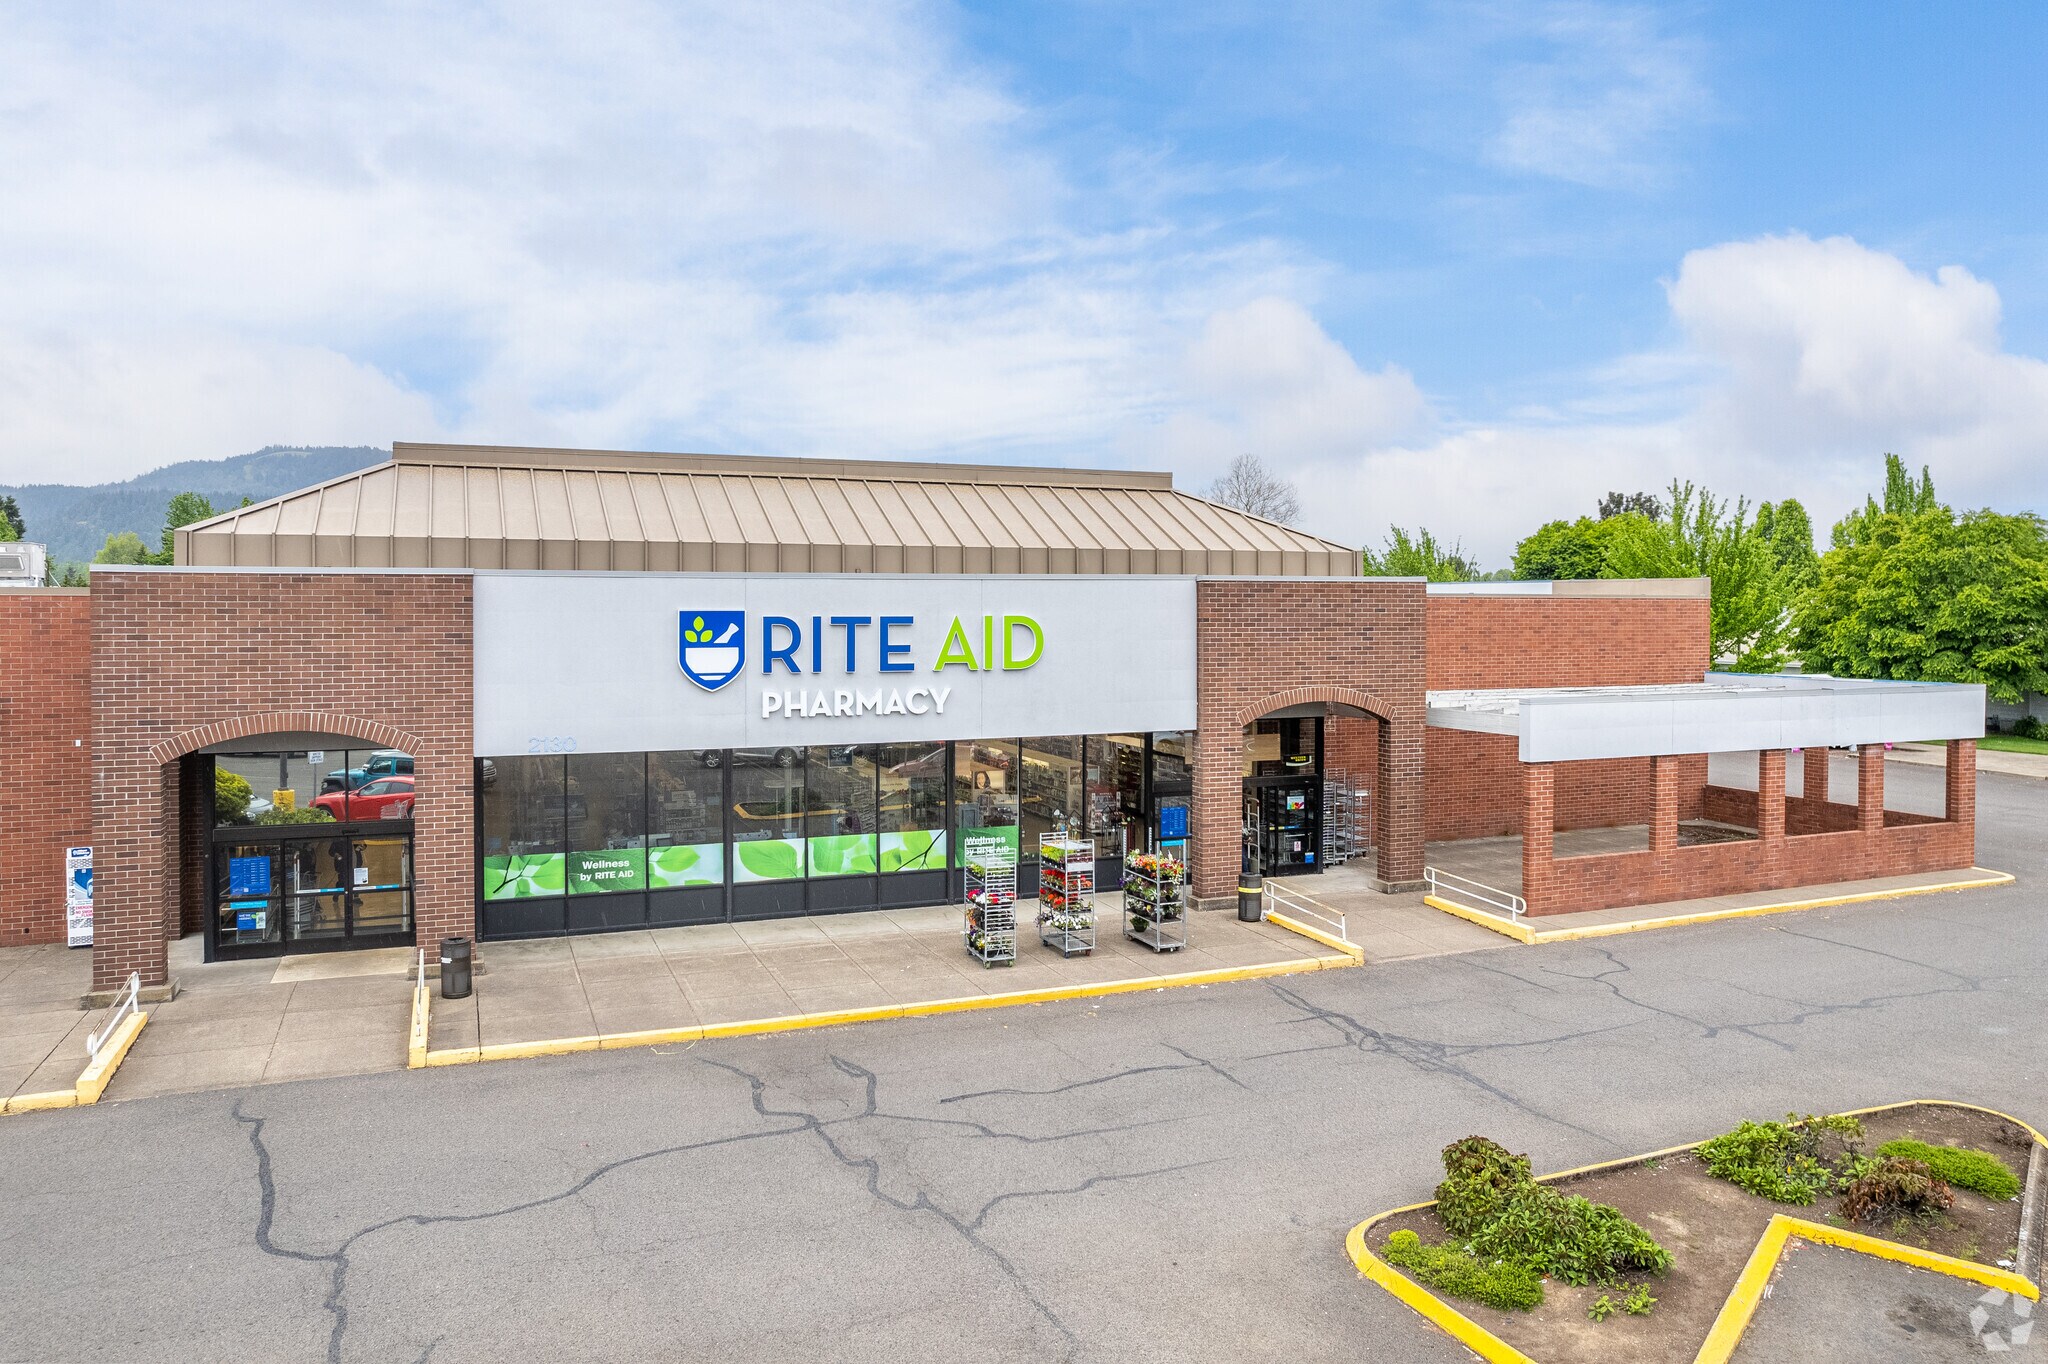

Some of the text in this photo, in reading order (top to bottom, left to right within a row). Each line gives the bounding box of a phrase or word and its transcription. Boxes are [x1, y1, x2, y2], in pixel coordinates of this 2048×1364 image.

[762, 614, 1045, 675] RITE AID
[761, 686, 952, 719] PHARMACY
[528, 735, 577, 753] 2130
[582, 860, 630, 869] Wellness
[580, 870, 634, 882] by RITE AID
